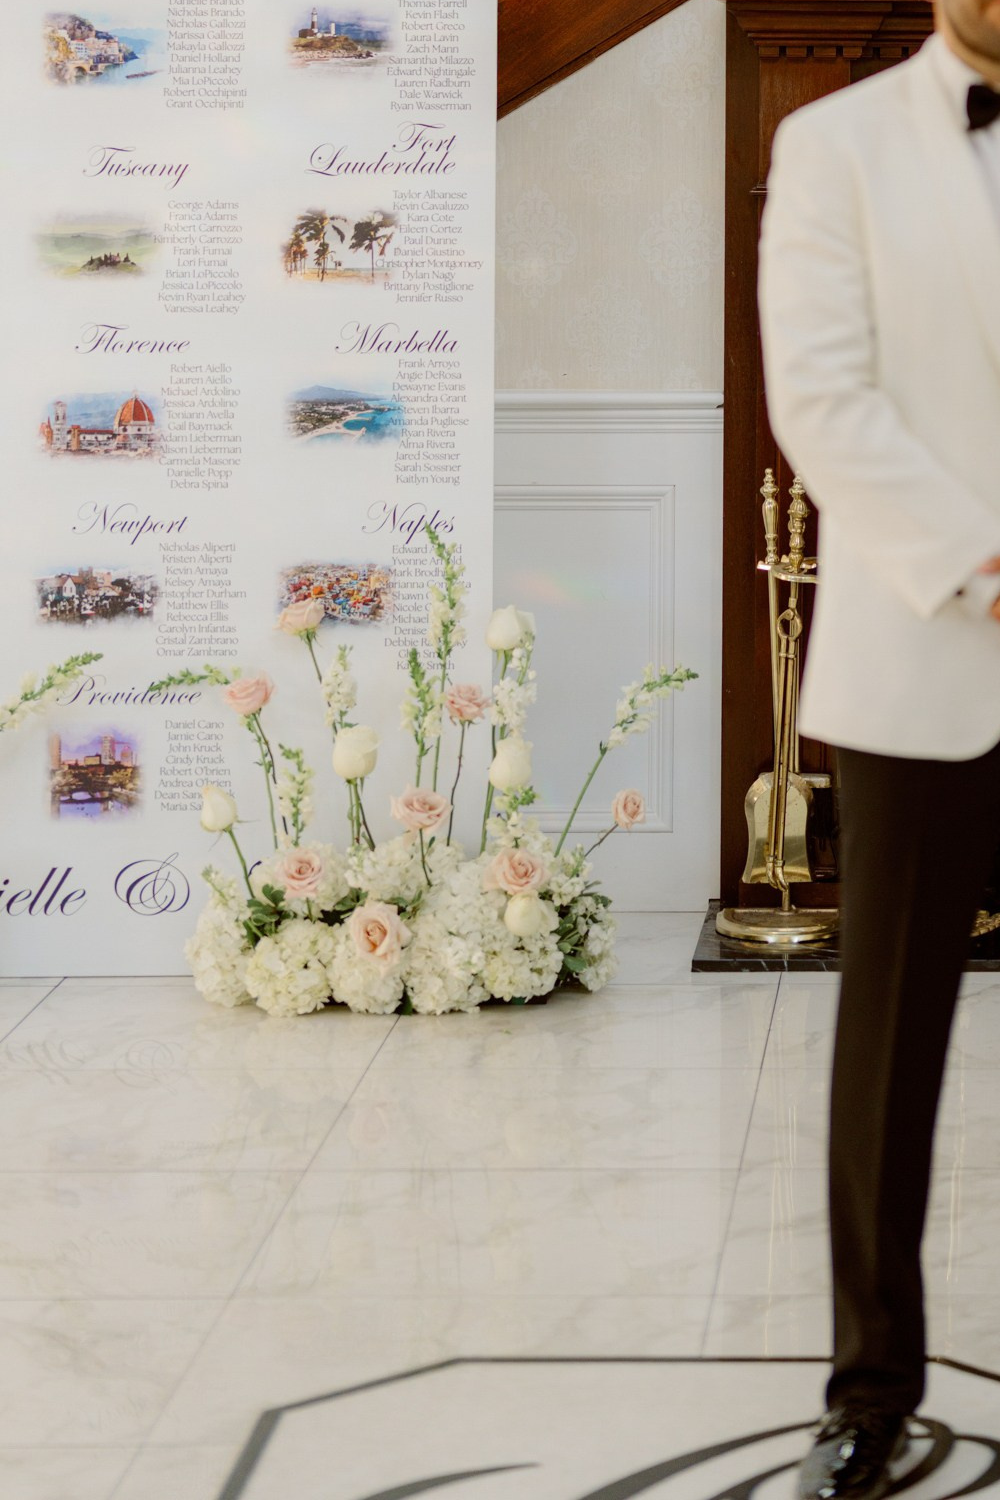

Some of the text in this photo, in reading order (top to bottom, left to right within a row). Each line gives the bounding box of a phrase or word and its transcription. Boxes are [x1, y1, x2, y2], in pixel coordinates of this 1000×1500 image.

[168, 8, 245, 16] Nicholas Brando
[406, 10, 459, 18] Kevin Flash
[167, 19, 246, 28] Nicholas Gallozzi
[402, 22, 465, 30] Robert Greco
[169, 30, 243, 39] Marissa Gallozzi
[406, 33, 459, 41] Laura Lavin
[167, 42, 245, 52] Makayla Gallozzi
[407, 44, 459, 53] Zach Mann
[171, 53, 240, 62] Daniel Holland
[388, 56, 474, 64] Samantha Milazzo
[168, 64, 242, 75] Julianna Leahey
[387, 67, 476, 78] Edward Nightingale
[173, 76, 238, 85] Mia LoPiccolo
[163, 87, 195, 96] Robert
[400, 90, 462, 98] Dale Warwick
[167, 99, 192, 108] Grant
[391, 101, 471, 112] Ryan Wasserman
[392, 121, 457, 152] Fort
[304, 143, 457, 177] Lauderdale
[83, 145, 190, 190] Tuscany
[393, 190, 467, 200] Taylor Albanese
[168, 200, 239, 211] George Adams
[393, 202, 469, 210] Kevin Cavaluzzo
[408, 213, 454, 222] Kara Cote
[165, 223, 242, 232] Robert Carrozzo
[400, 225, 462, 233] Eileen Cortez
[375, 259, 483, 270] Christopher Montgomery
[166, 269, 239, 278] Brian LoPiccolo
[403, 270, 456, 282] Dylan Nagy
[161, 281, 242, 290] Jessica LoPiccolo
[165, 304, 240, 315] Vanessa Leahey
[75, 322, 190, 354] Florence
[335, 321, 461, 354] Marbella
[171, 364, 232, 372] Robert Aiello
[398, 359, 460, 370] Frank Arroyo
[170, 376, 232, 384] Lauren Aiello
[396, 371, 462, 381] Angie DeRosa
[161, 387, 240, 396] Michael Ardolino
[393, 382, 466, 392] Dewayne Evans
[402, 428, 456, 439] Ryan Rivera
[395, 463, 461, 472] Sarah Sossner
[167, 468, 232, 479] Danielle Popp
[171, 480, 229, 491] Debra Spina
[72, 501, 189, 545] Newport
[362, 500, 456, 545] Naples
[163, 554, 232, 565] Kristen Aliperti
[392, 557, 427, 565] Yvonne
[166, 566, 192, 574] Kevin
[167, 612, 229, 621] Rebecca Ellis
[56, 674, 202, 706] Providence
[165, 720, 224, 729] Daniel Cano
[168, 743, 222, 753] John Kruck
[166, 754, 224, 766] Cindy Kruck
[160, 767, 192, 775] Robert
[0, 852, 190, 916] ielle &
